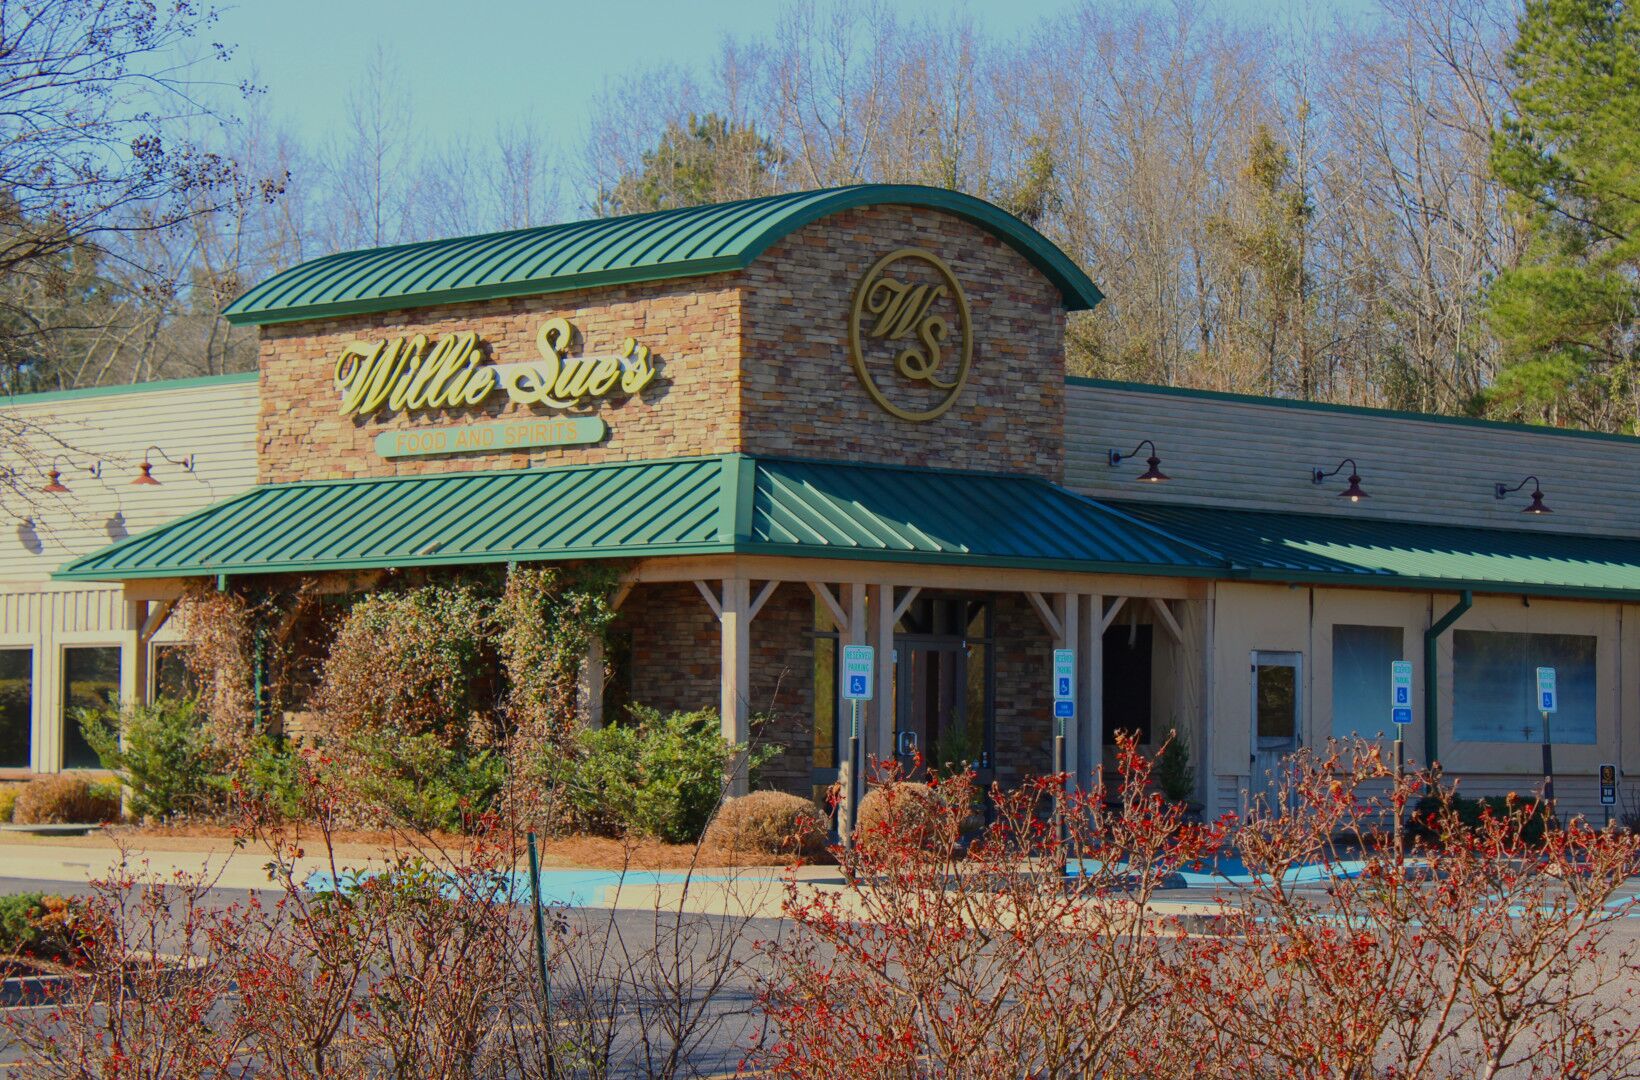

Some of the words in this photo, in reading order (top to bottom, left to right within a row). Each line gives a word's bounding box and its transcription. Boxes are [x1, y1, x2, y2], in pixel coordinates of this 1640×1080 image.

[334, 332, 497, 415] Willie
[506, 317, 655, 408] Sue's
[396, 431, 447, 454] FOOD
[455, 428, 495, 449] AND
[504, 422, 577, 445] SPIRITS
[847, 651, 871, 660] RESERVED
[848, 663, 868, 672] PARKING
